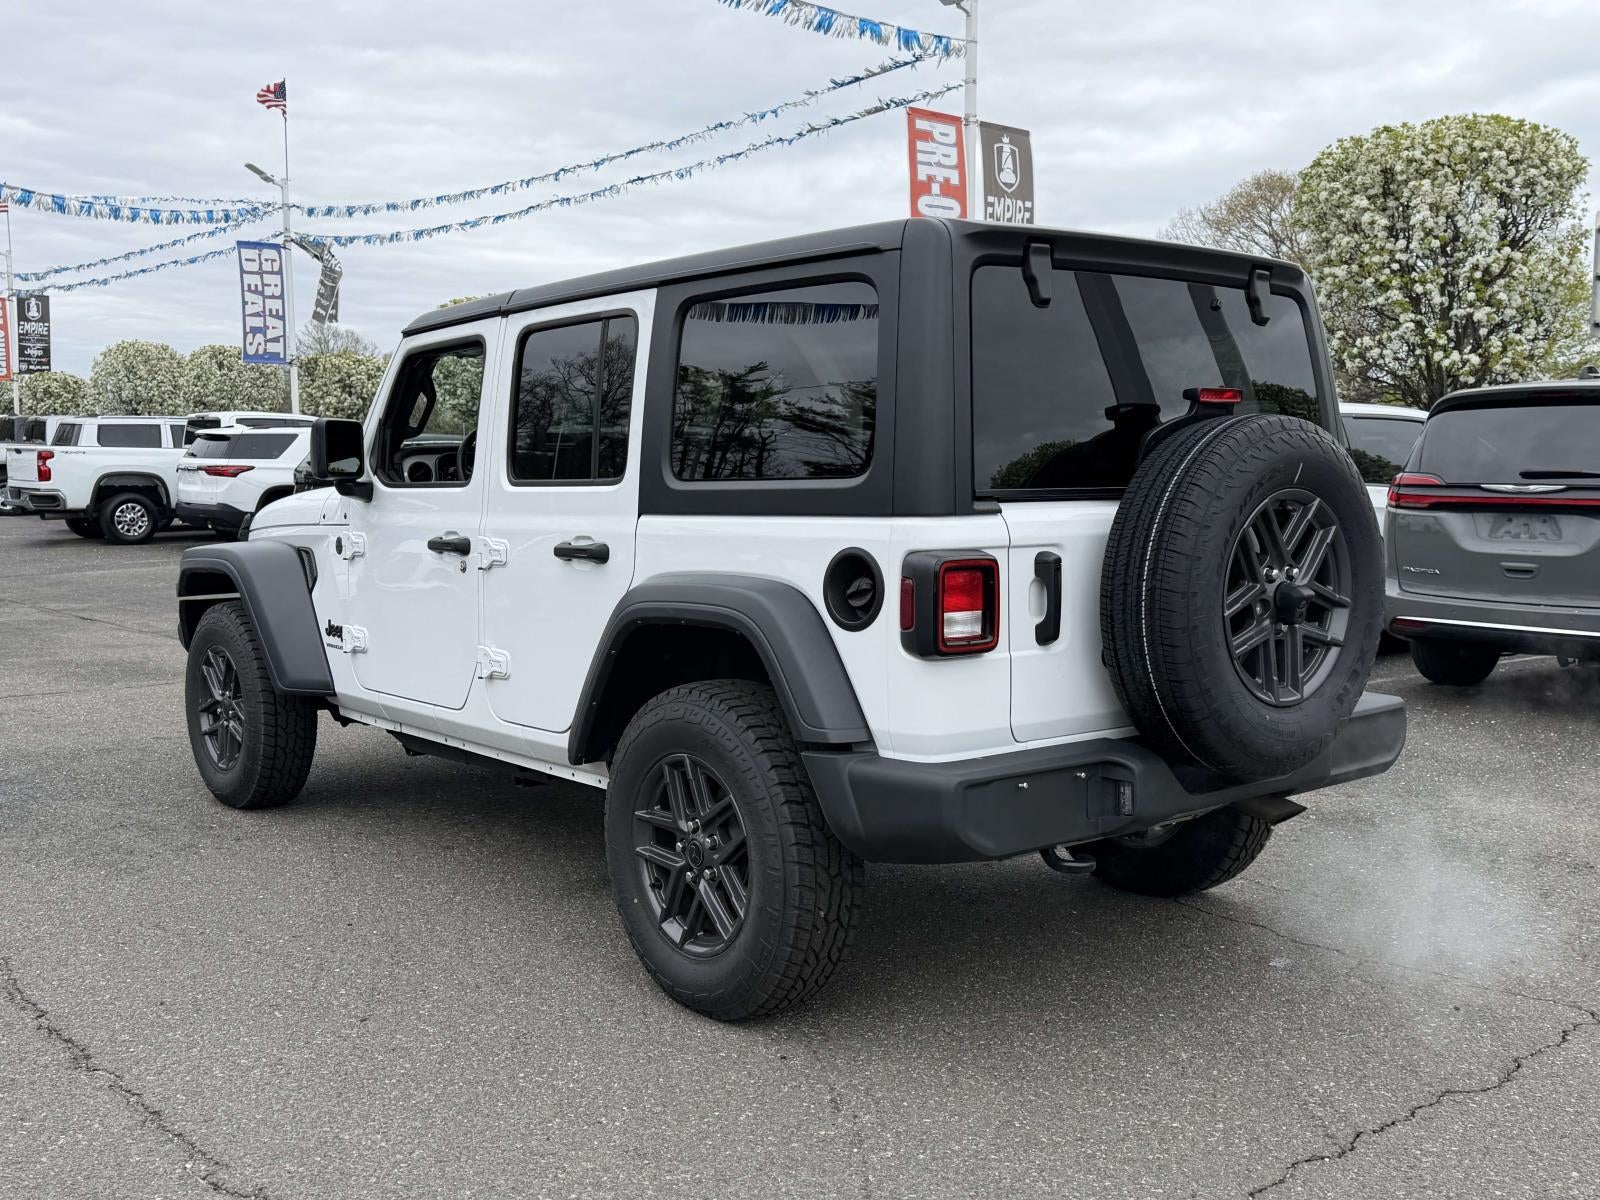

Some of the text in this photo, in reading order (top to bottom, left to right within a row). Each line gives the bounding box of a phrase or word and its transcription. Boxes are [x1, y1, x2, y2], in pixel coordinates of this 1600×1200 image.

[986, 196, 1032, 224] EMPIRE
[19, 321, 49, 335] EMPIRE
[240, 248, 265, 356] DEALS
[261, 248, 284, 358] GREAT
